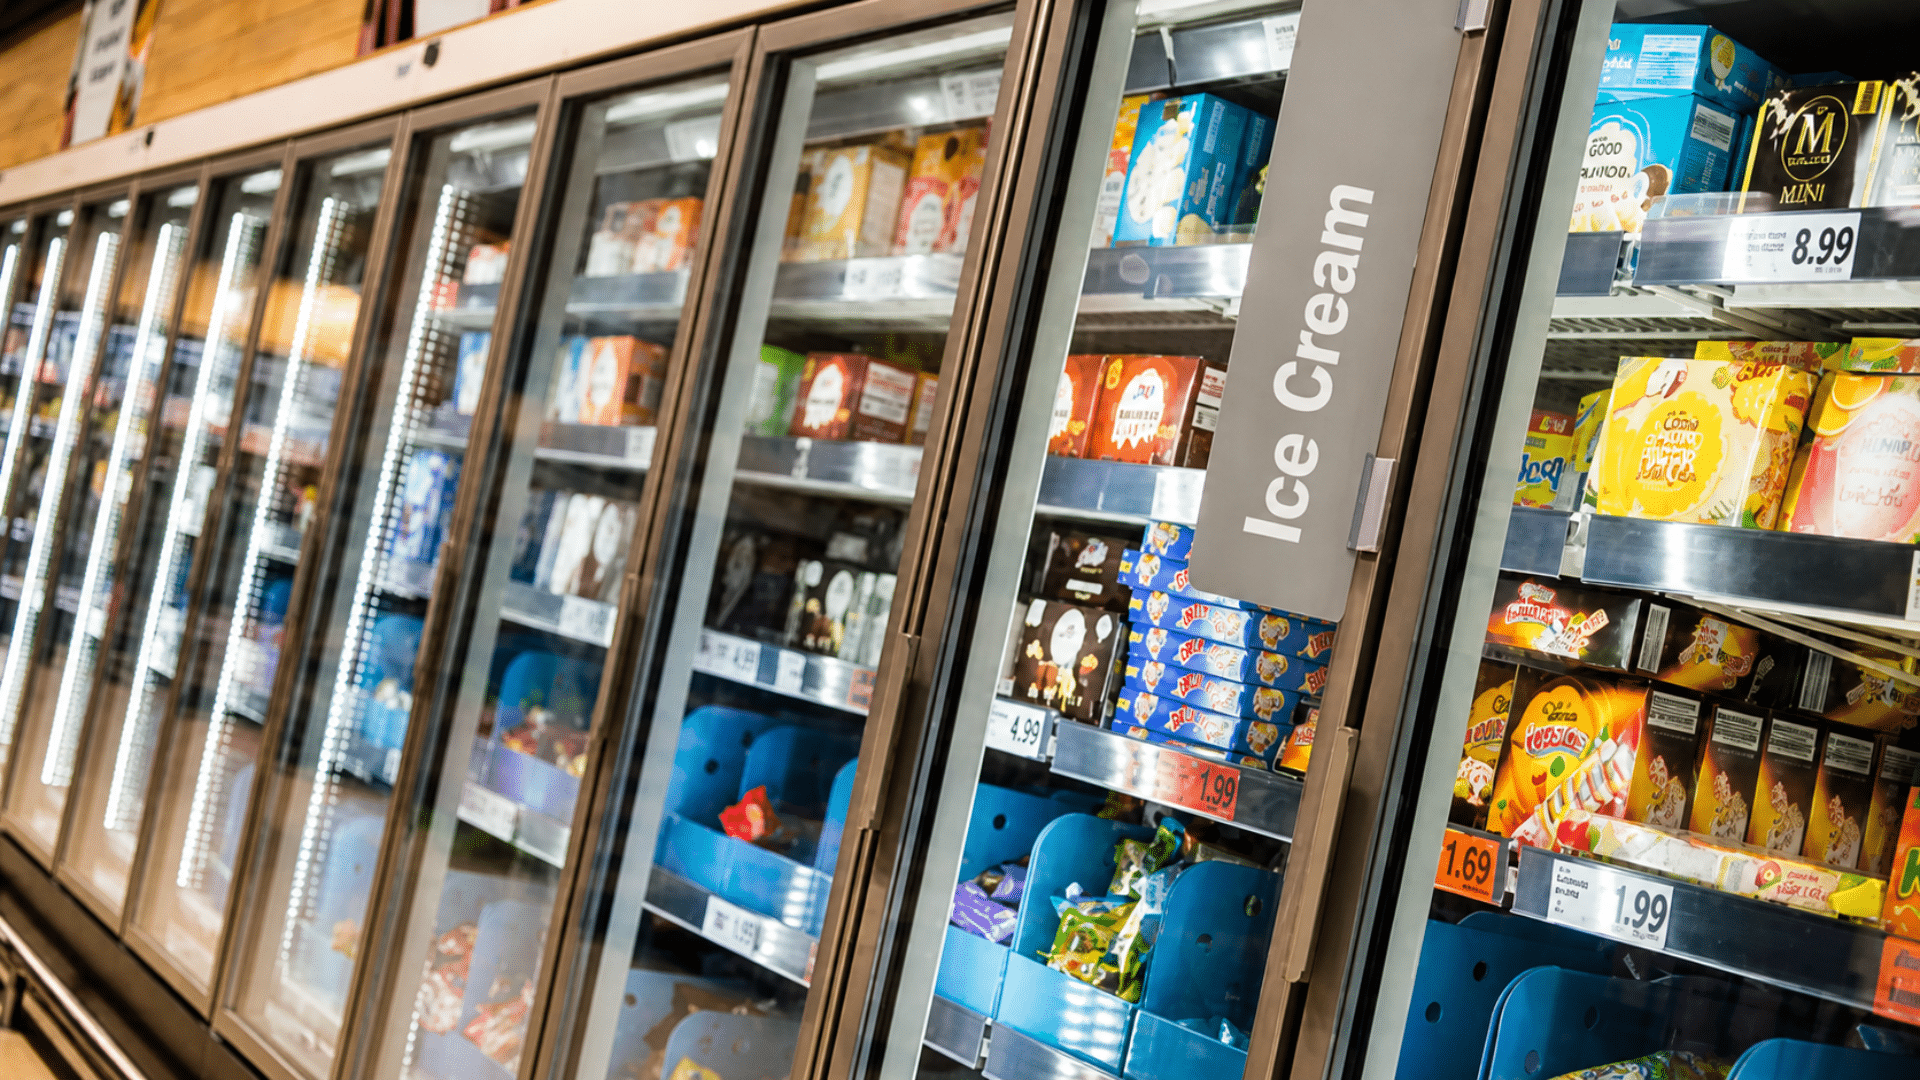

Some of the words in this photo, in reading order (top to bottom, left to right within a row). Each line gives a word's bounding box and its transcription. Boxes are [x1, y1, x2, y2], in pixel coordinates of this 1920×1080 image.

[1589, 142, 1622, 157] GOOD
[1793, 112, 1836, 155] M
[1779, 182, 1826, 205] MINI
[1791, 226, 1854, 265] 8.99
[1273, 184, 1374, 412] Cream
[1243, 434, 1319, 543] Ice
[1010, 715, 1040, 745] 4.99
[1200, 766, 1235, 808] 1.99
[1446, 840, 1491, 884] 1.69
[1615, 885, 1668, 933] 1.99
